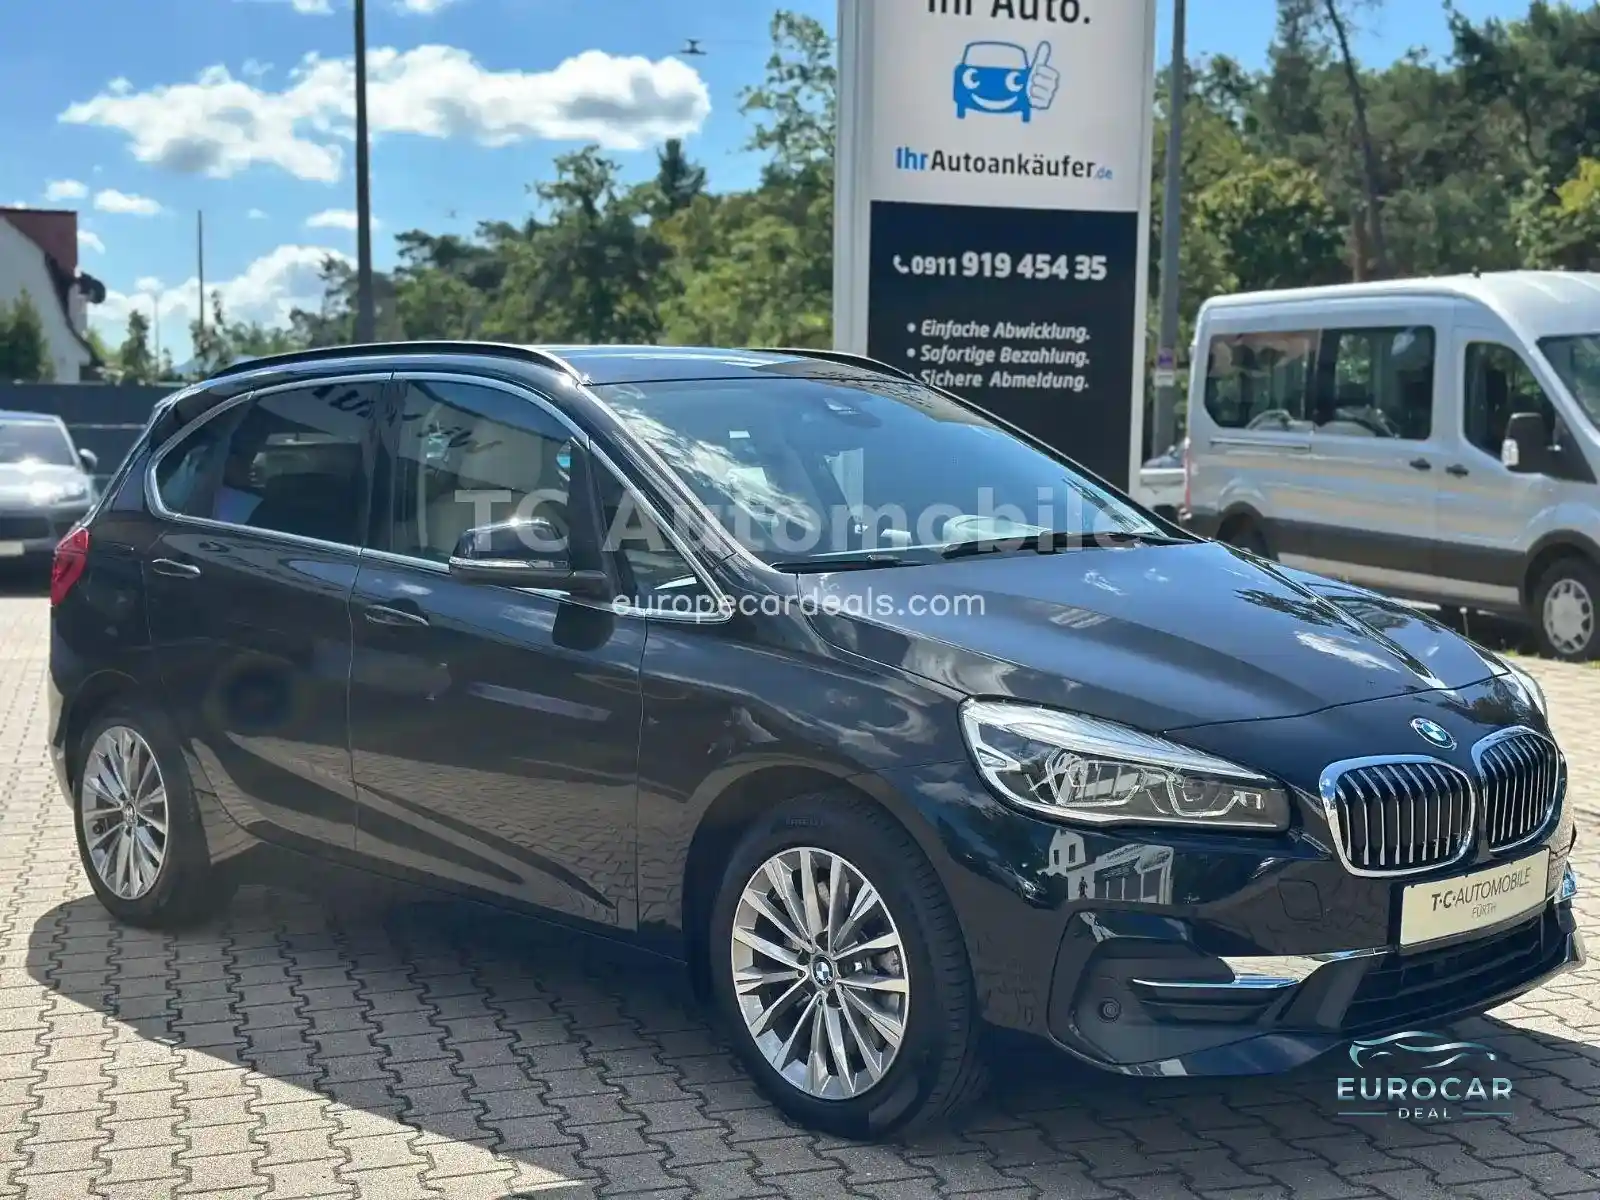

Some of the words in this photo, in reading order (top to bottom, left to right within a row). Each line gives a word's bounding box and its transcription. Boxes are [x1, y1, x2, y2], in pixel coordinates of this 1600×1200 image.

[990, 0, 1091, 24] Auto.
[911, 255, 957, 276] 0911
[962, 251, 1012, 278] 919
[1016, 253, 1069, 280] 454
[1074, 254, 1108, 281] 35
[920, 318, 990, 339] Einfache
[992, 321, 1091, 344] Abwicklung.
[920, 344, 996, 366] Sofortige
[1000, 346, 1090, 368] Bezahlung.
[989, 370, 1089, 392] Abmeldung.
